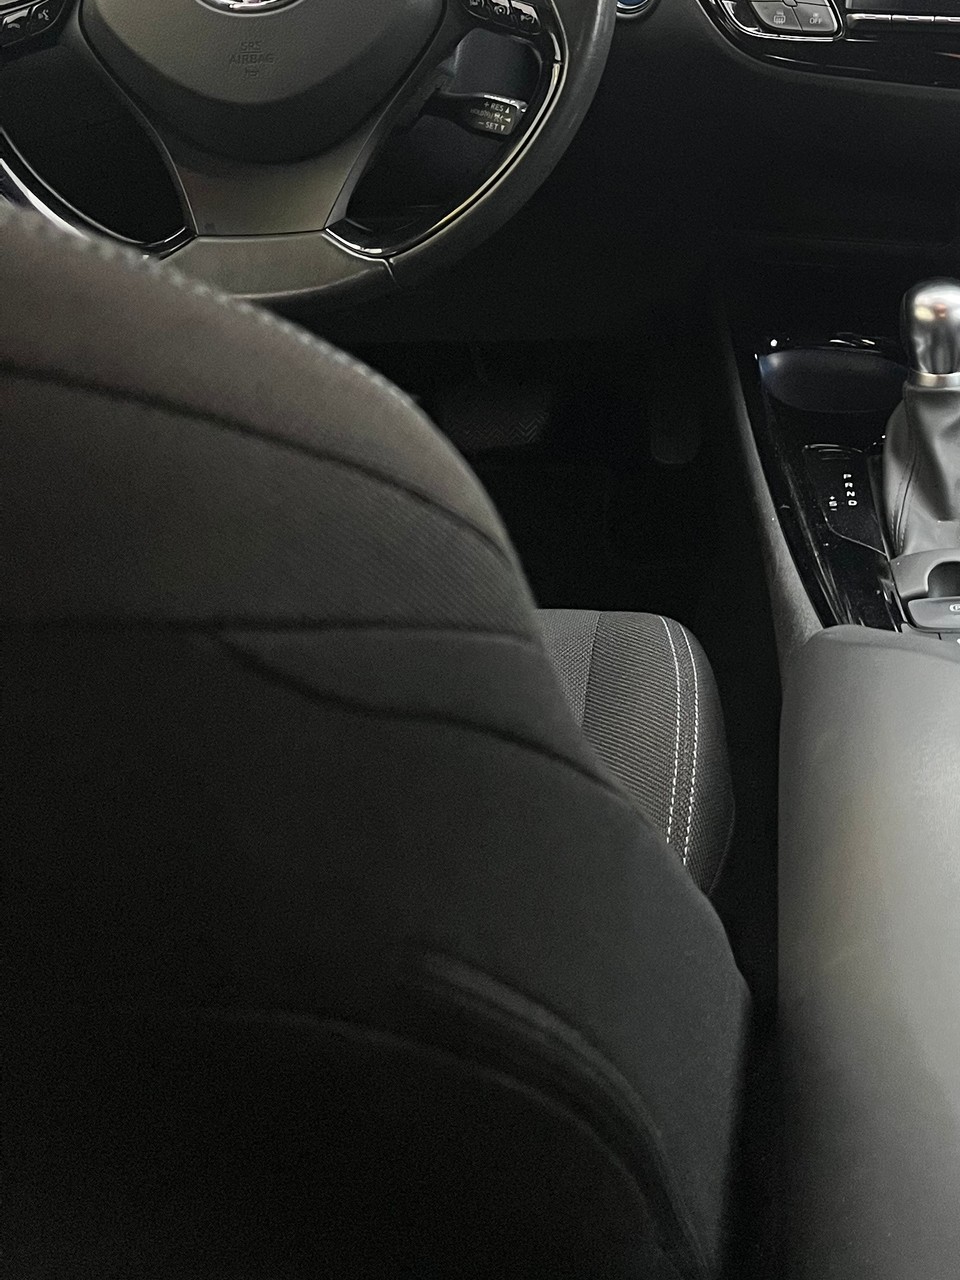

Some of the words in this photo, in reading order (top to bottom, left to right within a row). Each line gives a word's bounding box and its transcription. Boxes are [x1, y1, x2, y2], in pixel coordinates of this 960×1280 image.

[809, 17, 822, 25] OFF
[490, 102, 504, 112] RES
[485, 121, 499, 130] SET
